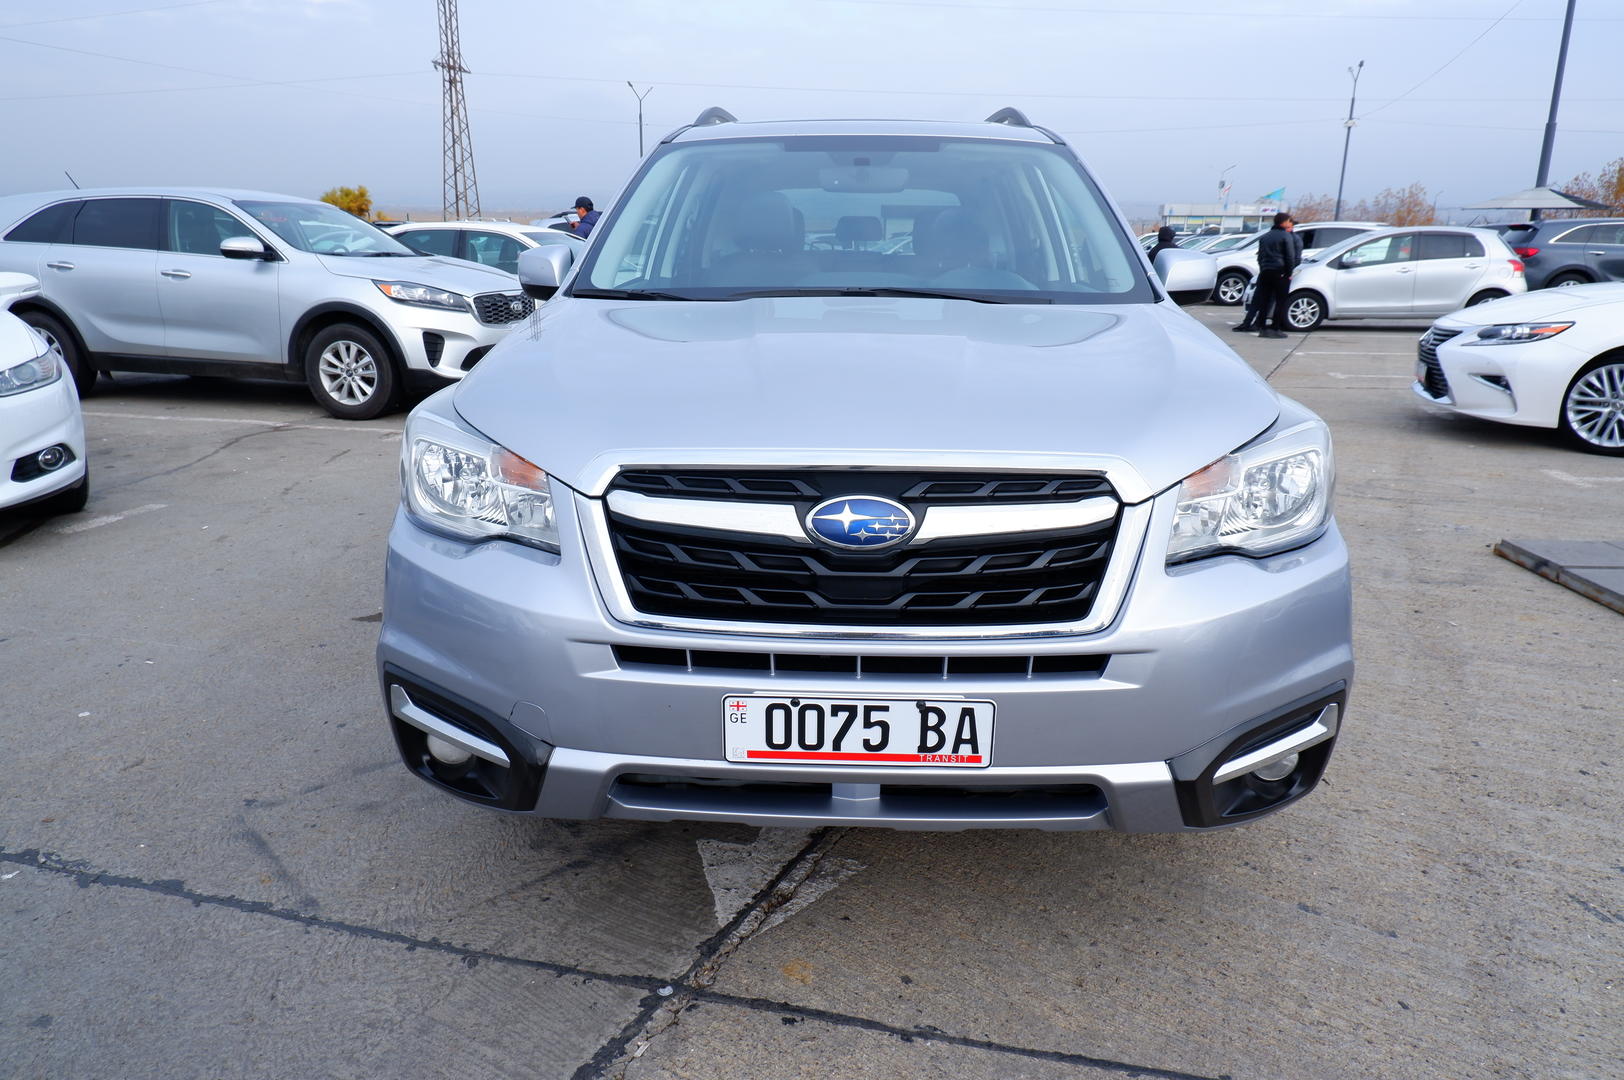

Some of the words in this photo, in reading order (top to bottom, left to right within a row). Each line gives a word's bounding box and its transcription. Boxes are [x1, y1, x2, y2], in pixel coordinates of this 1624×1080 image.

[729, 713, 747, 724] GE
[765, 703, 890, 752] 0075
[917, 706, 979, 754] BA
[919, 754, 969, 763] TRANSIT
